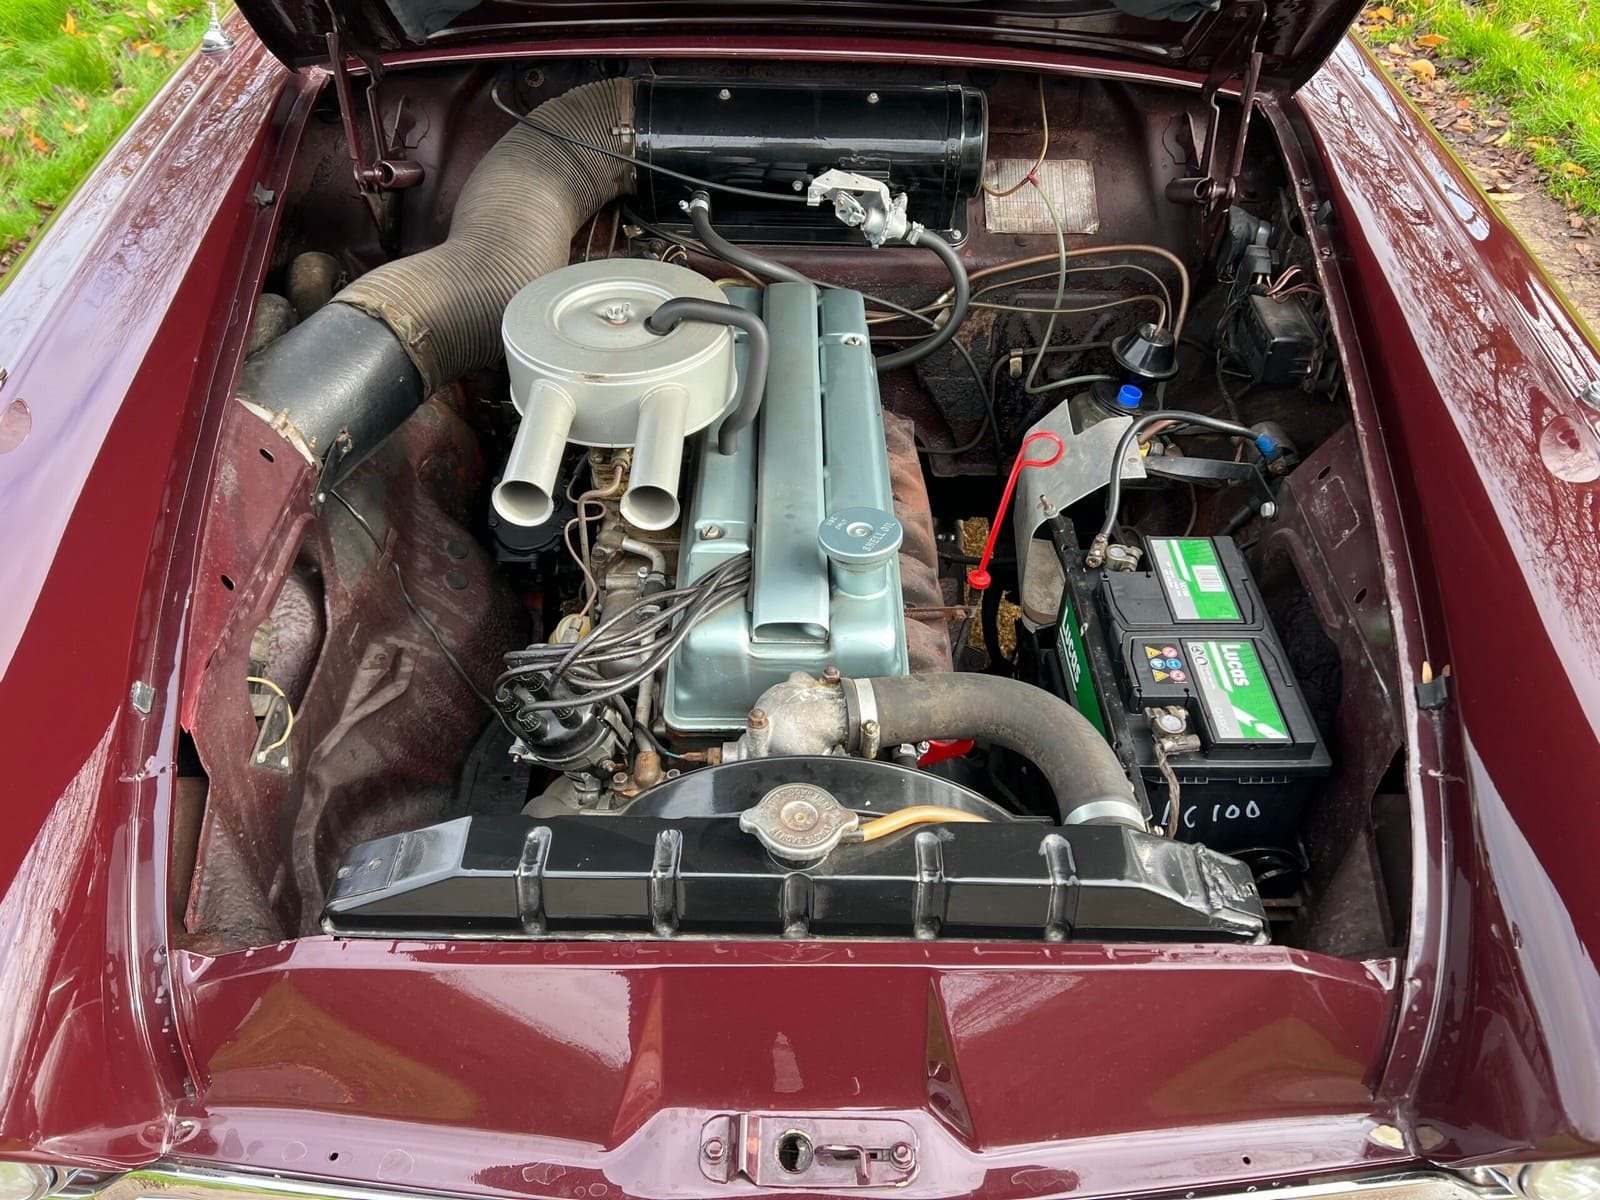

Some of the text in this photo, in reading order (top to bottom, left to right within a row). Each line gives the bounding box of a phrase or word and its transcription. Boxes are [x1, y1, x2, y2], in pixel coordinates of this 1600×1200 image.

[862, 521, 896, 552] SHELL OIL
[1212, 800, 1261, 822] 100
